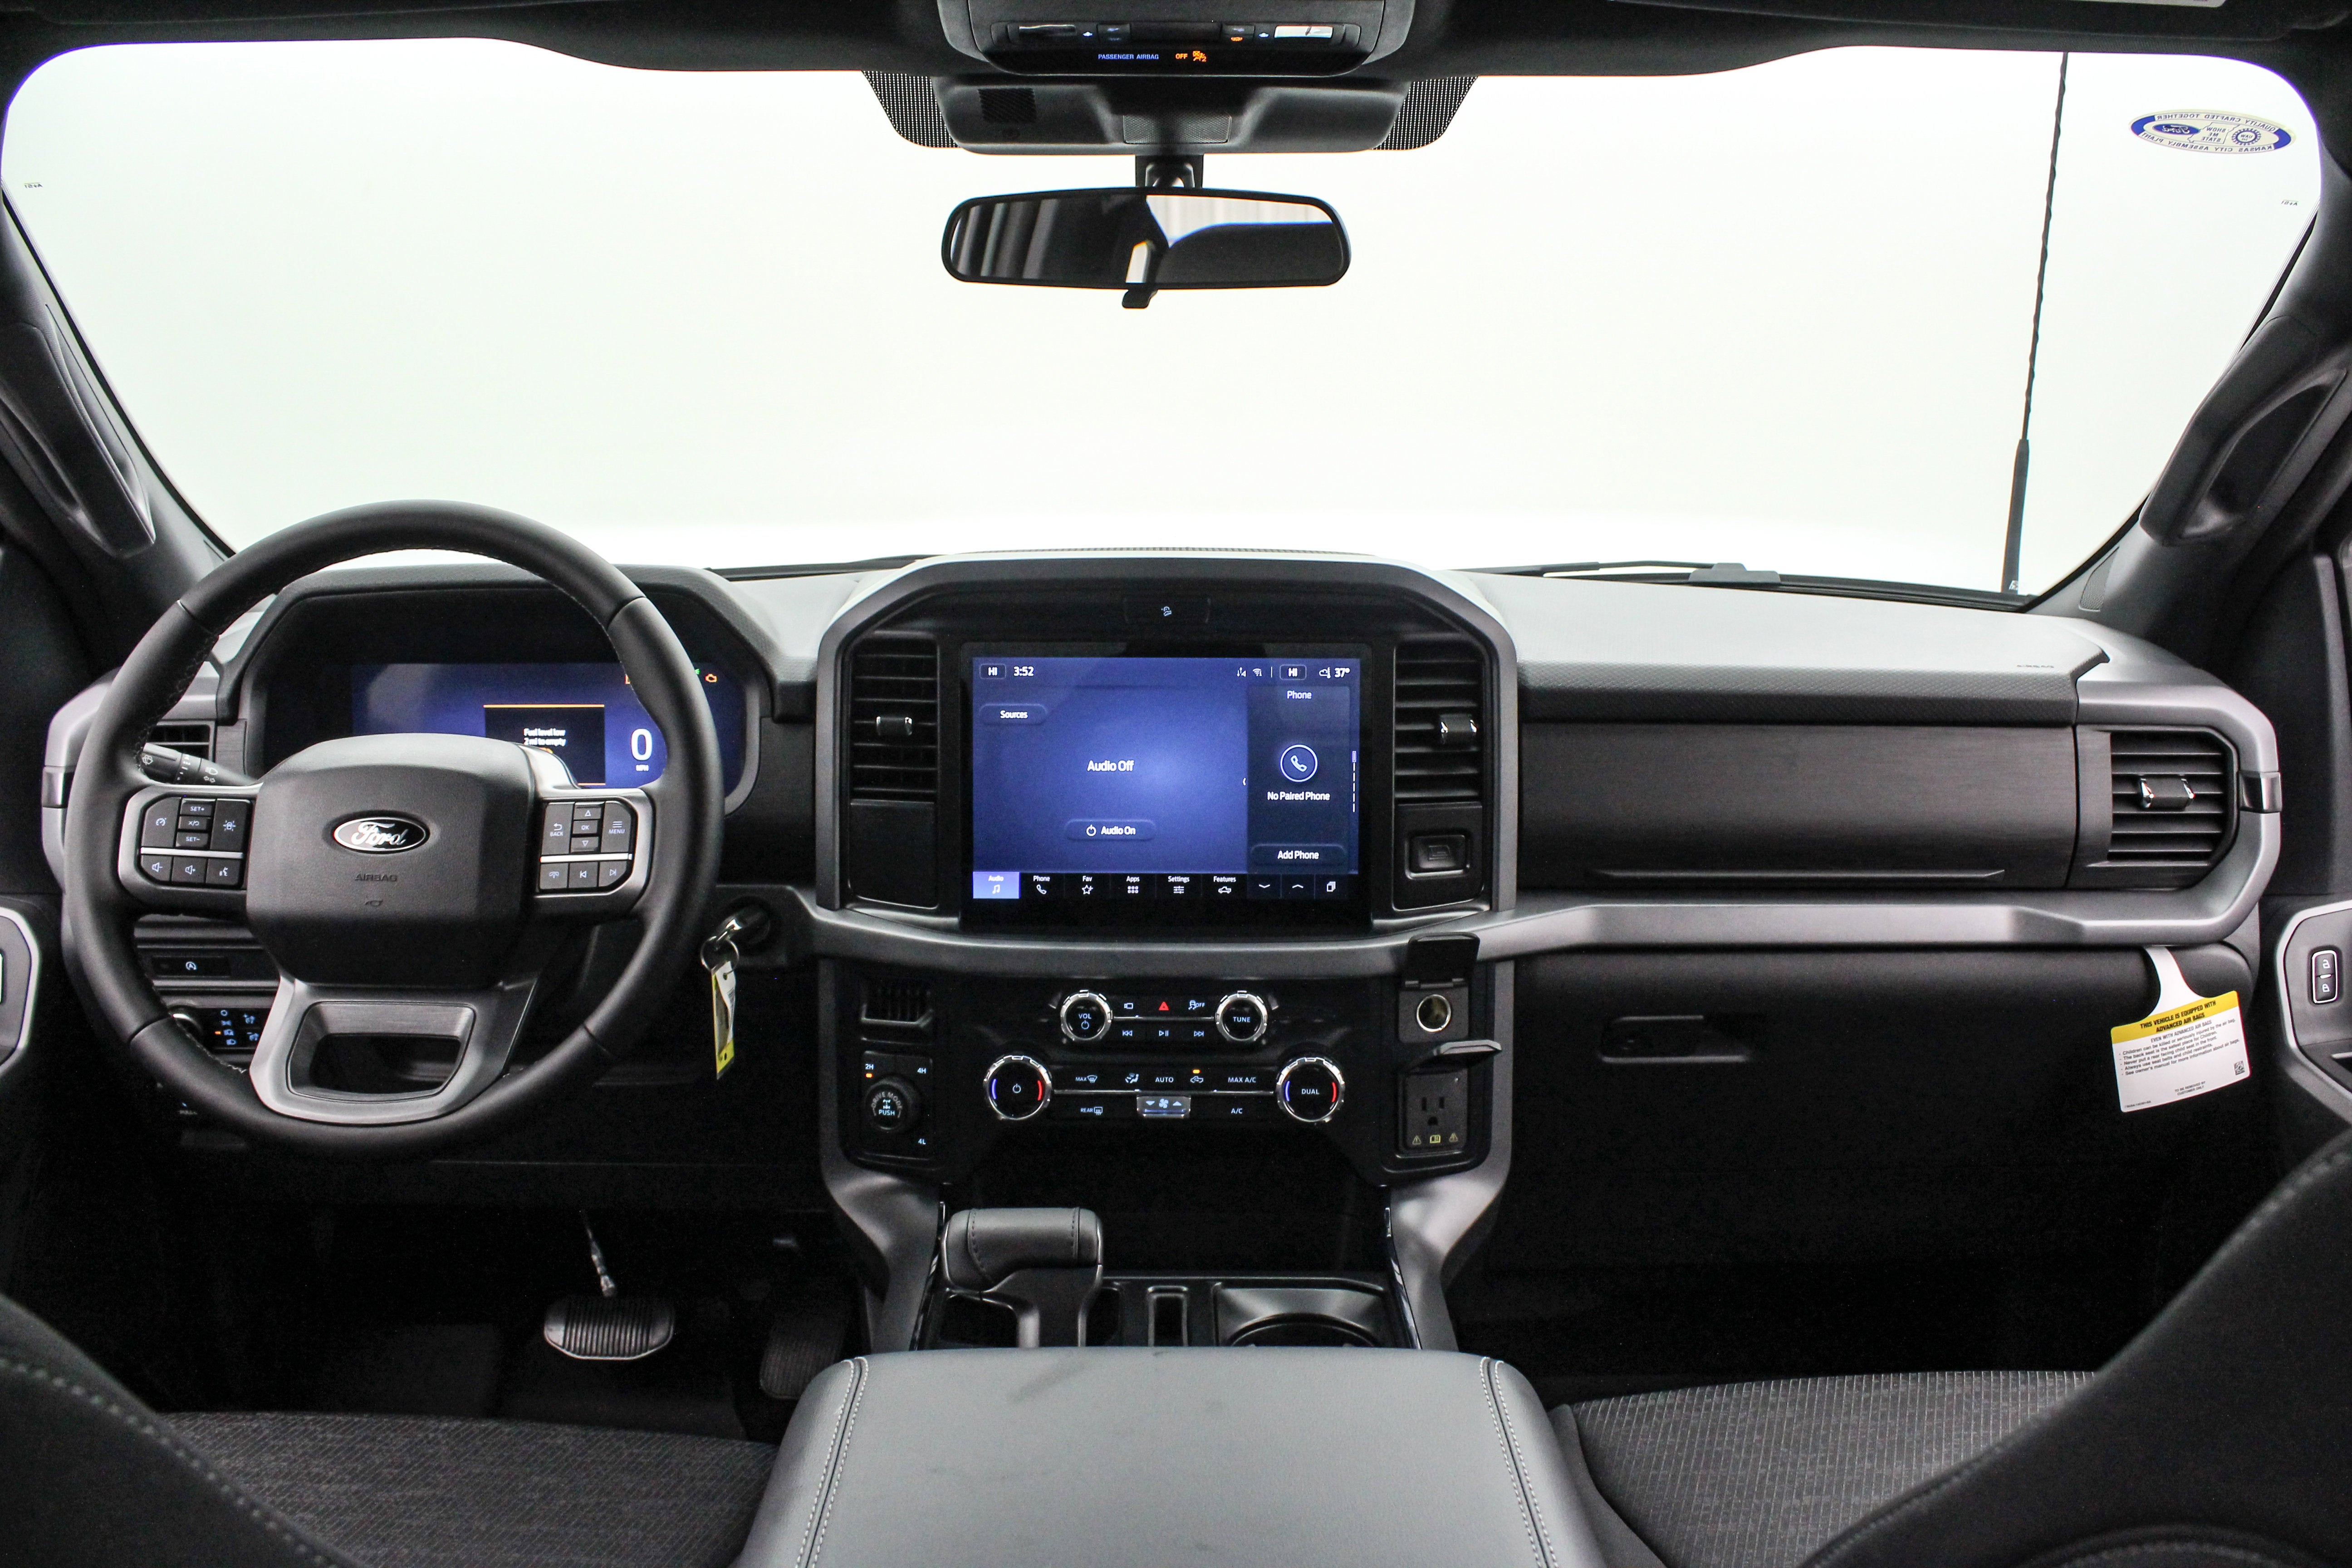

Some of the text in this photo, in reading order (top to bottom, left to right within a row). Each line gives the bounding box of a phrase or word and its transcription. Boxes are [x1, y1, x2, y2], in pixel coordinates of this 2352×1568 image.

[988, 667, 998, 676] HI
[1014, 666, 1034, 676] 3:52
[1288, 667, 1298, 677] HI
[1286, 690, 1313, 699] Phone
[1000, 710, 1028, 719] Sources
[630, 728, 652, 761] 0
[1087, 760, 1134, 772] Audio Off
[1267, 791, 1330, 800] No Paired Phone
[351, 821, 408, 845] Ford
[1101, 826, 1136, 835] Audio On
[1277, 850, 1319, 859] Add Phone
[355, 873, 398, 882] AIRBAG
[2154, 1015, 2174, 1025] VEHICLE
[2181, 1005, 2203, 1017] EQUIPPED
[2204, 1000, 2216, 1009] WITH
[2156, 1021, 2182, 1033] ADVANCED
[2193, 1012, 2205, 1021] BAGS
[2174, 1026, 2194, 1036] ADVANCED
[871, 1091, 902, 1109] DRIVE MODE
